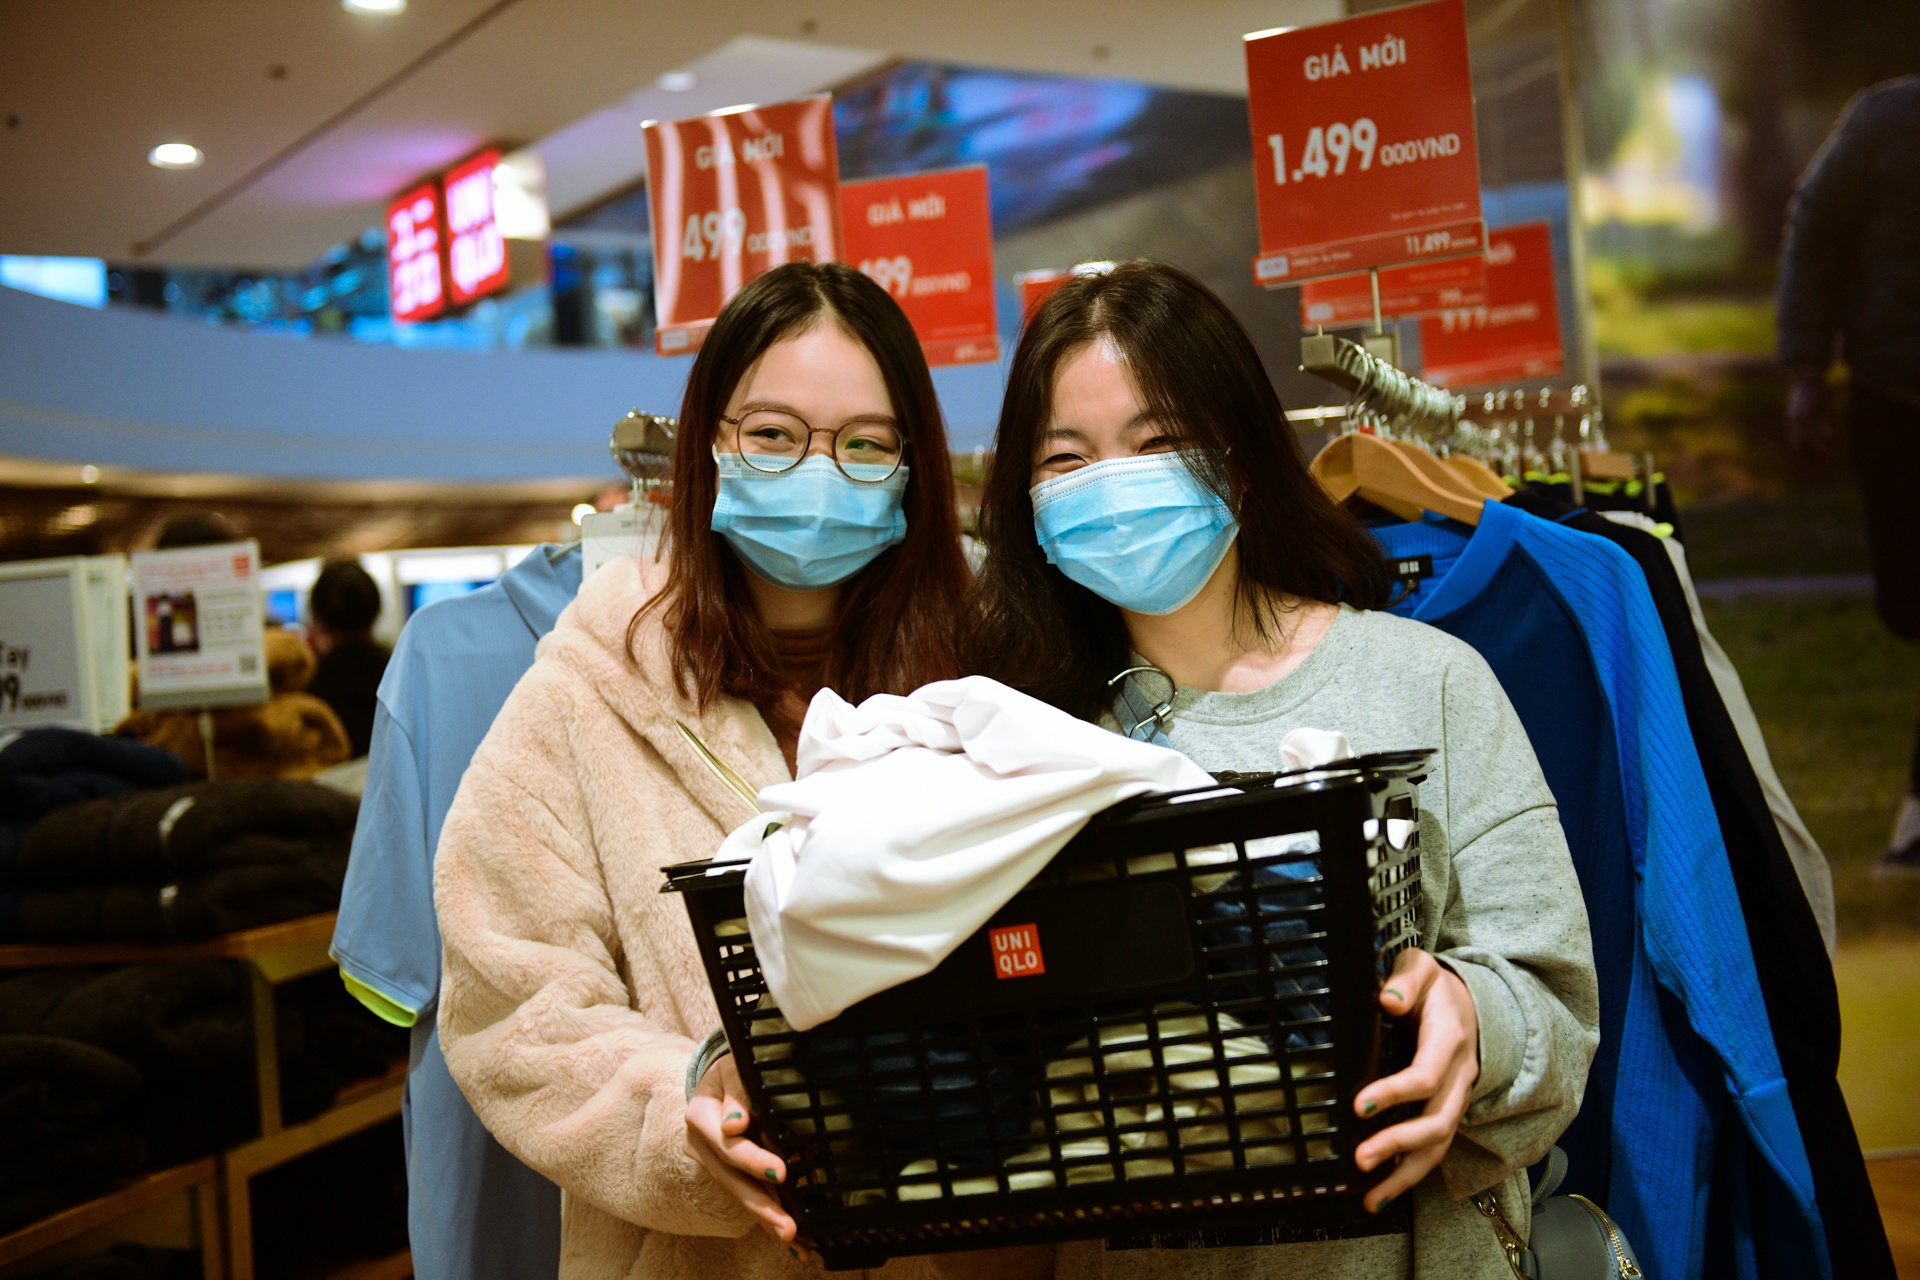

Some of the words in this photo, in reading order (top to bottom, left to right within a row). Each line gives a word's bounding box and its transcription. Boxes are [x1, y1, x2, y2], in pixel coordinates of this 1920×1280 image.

[1304, 43, 1350, 81] GIÁ
[1359, 33, 1407, 71] MỚI
[1268, 117, 1377, 186] 1.499
[683, 207, 746, 261] 499
[995, 930, 1031, 952] UNI
[999, 950, 1038, 976] QLO
